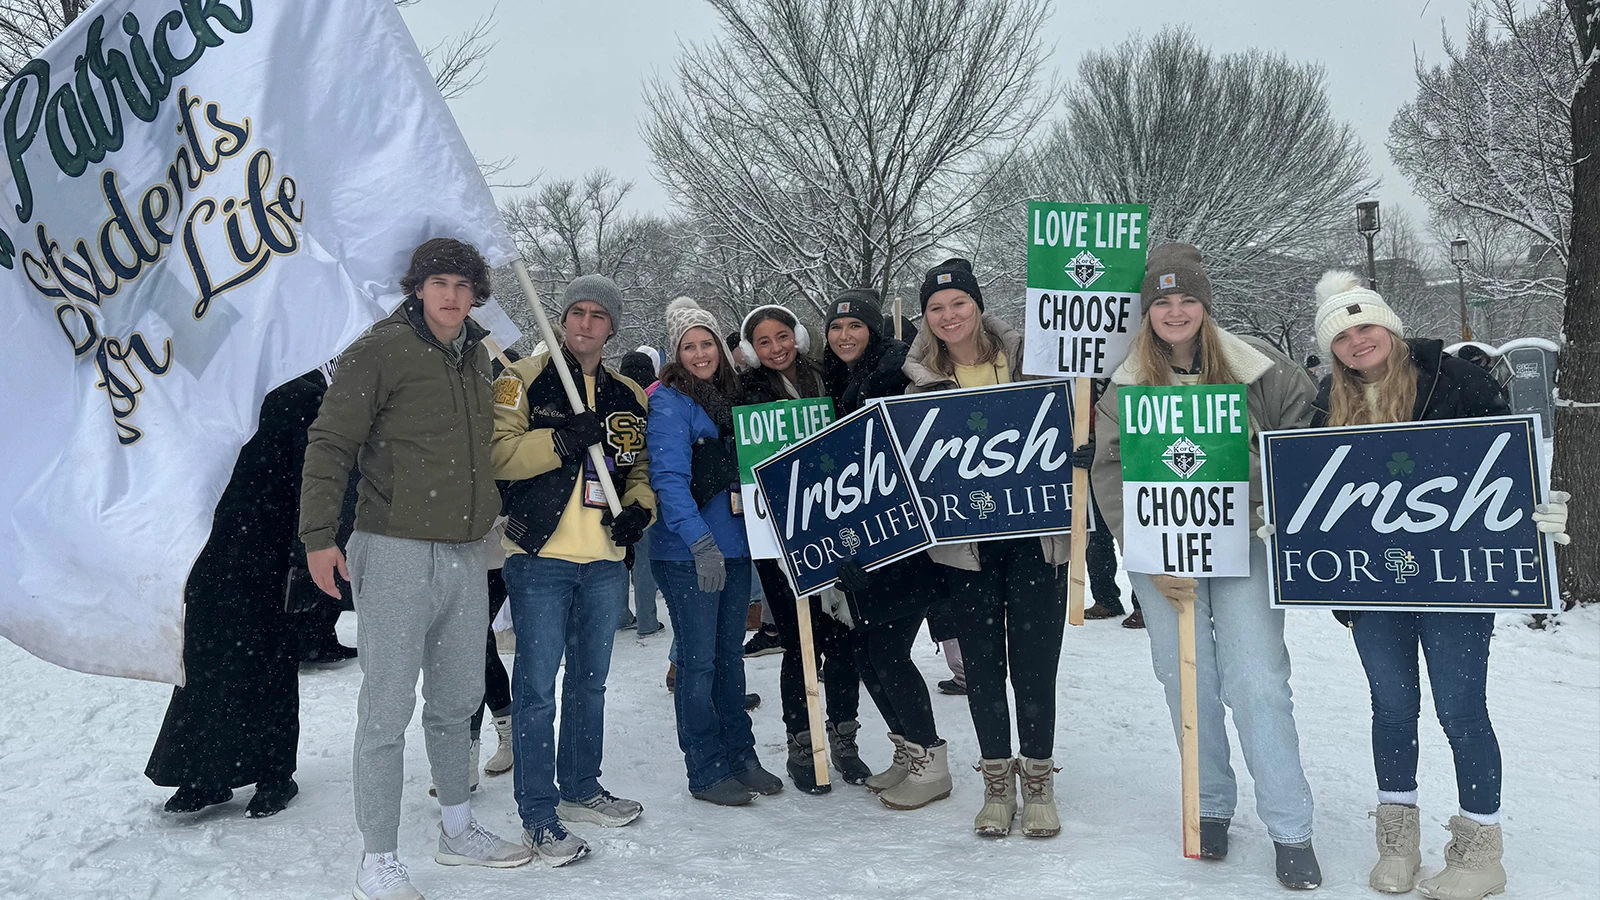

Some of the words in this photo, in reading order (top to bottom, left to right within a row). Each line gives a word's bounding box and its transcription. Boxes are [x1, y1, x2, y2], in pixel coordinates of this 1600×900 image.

[2, 0, 253, 223] Patrick
[21, 85, 251, 356] Students
[1034, 209, 1088, 247] LOVE
[1095, 212, 1142, 249] LIFE
[94, 331, 173, 445] for
[181, 148, 304, 321] Life
[1039, 293, 1131, 333] CHOOSE
[1058, 337, 1106, 373] LIFE
[738, 409, 788, 446] LOVE
[1124, 394, 1184, 435] LOVE
[1191, 393, 1242, 434] LIFE
[904, 392, 1067, 482] Irish
[786, 417, 898, 541] Irish
[1286, 431, 1523, 534] Irish
[919, 493, 969, 523] OR
[1137, 486, 1235, 527] CHOOSE
[789, 536, 845, 577] FOR
[861, 500, 919, 547] LIFE
[1161, 532, 1213, 573] LIFE
[1282, 549, 1383, 583] FOR
[1431, 548, 1538, 584] LIFE
